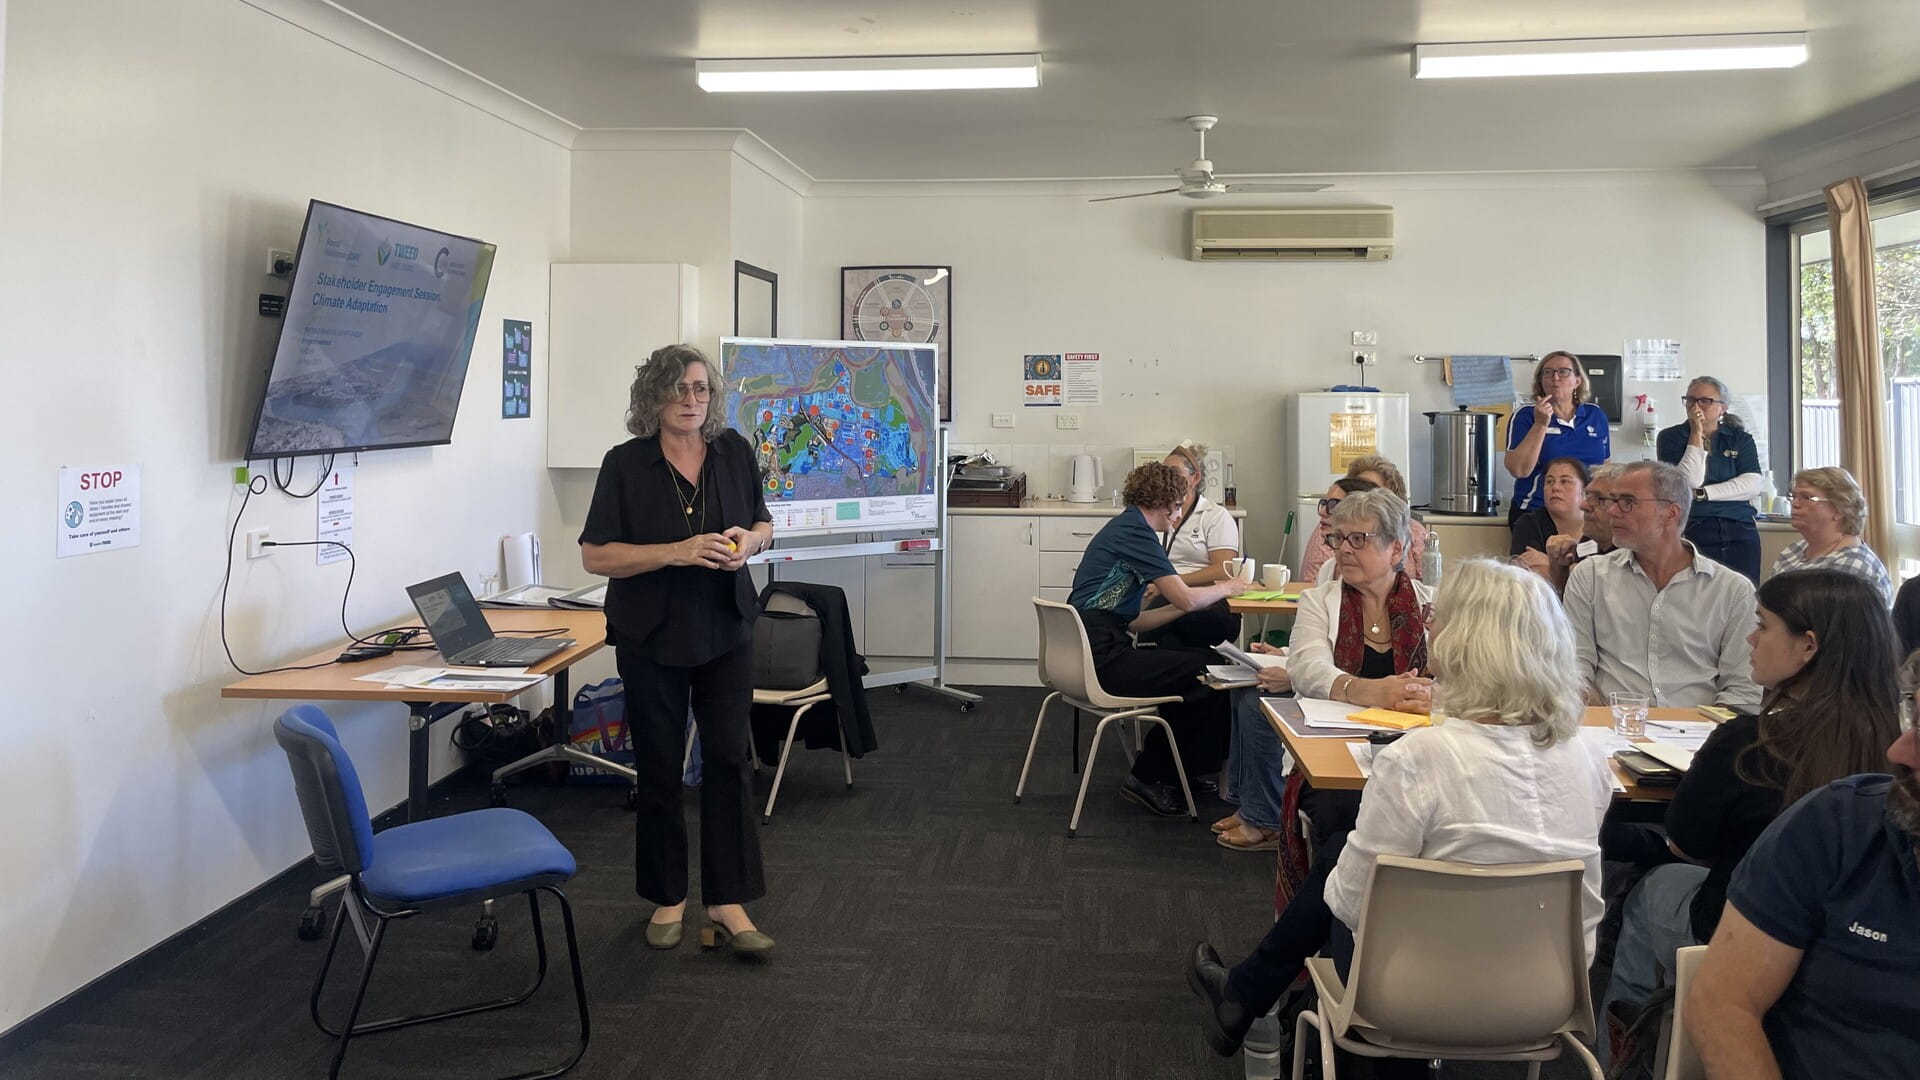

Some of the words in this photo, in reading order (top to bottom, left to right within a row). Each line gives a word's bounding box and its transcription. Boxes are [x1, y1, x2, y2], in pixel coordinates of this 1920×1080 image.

[395, 243, 419, 259] TWEED
[317, 272, 369, 292] Stakeholder
[368, 280, 413, 298] Engagement
[312, 292, 345, 309] Climate
[345, 297, 389, 313] Adaptation
[1025, 384, 1061, 396] SAFE
[80, 471, 122, 491] STOP
[1848, 921, 1888, 942] Jason
